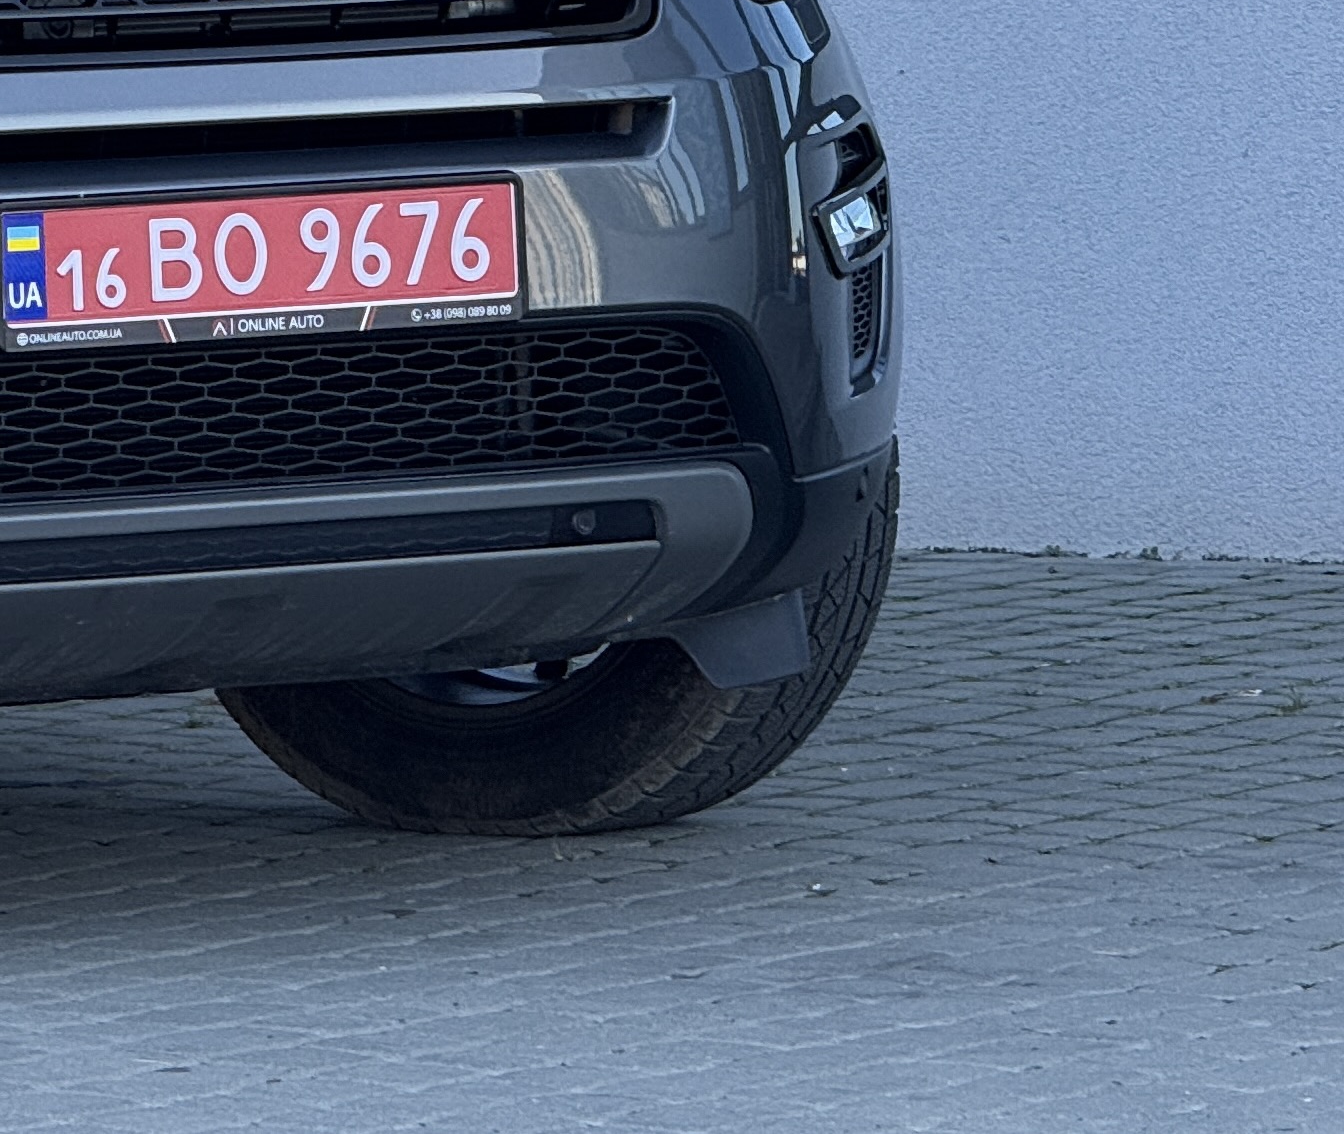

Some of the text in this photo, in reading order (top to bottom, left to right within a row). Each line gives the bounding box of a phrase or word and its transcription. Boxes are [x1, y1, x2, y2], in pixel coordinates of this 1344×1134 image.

[56, 197, 491, 311] 16 BO 9676
[8, 281, 43, 309] UA
[237, 314, 325, 333] ONLINE AUTO
